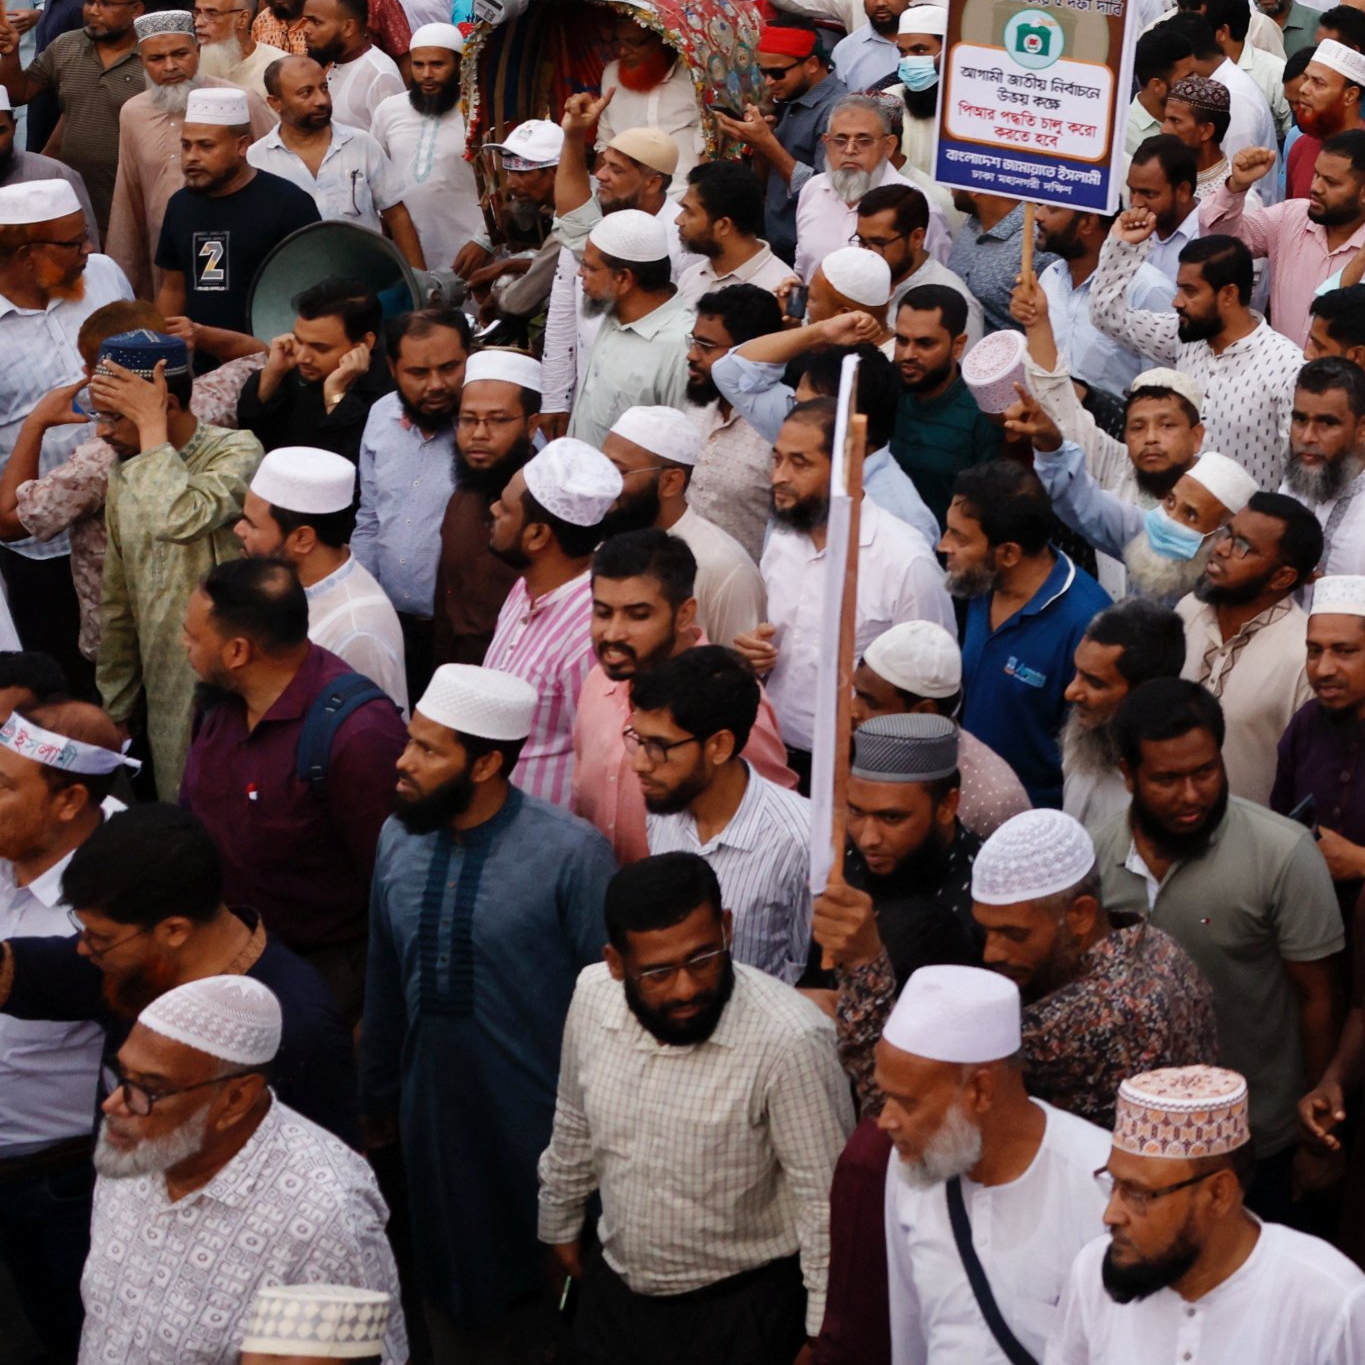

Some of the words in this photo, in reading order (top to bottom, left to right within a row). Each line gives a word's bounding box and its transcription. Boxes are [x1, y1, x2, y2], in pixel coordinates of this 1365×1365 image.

[960, 66, 1003, 83] আগামী
[1007, 72, 1047, 91] জাতীয়
[1050, 76, 1100, 99] নির্বাচনে
[997, 86, 1029, 105] উভয়
[1032, 95, 1061, 109] কক্ষে
[958, 100, 996, 120] পিআর
[1000, 110, 1036, 126] পদ্ধতি
[1040, 117, 1063, 134] চালু
[1066, 121, 1097, 137] করো
[993, 126, 1030, 142] করতে
[1034, 133, 1058, 146] হবে
[945, 148, 1001, 168] বাংলাদেশ
[1002, 158, 1056, 177] জামায়াতে
[1057, 164, 1101, 185] ইসলামী
